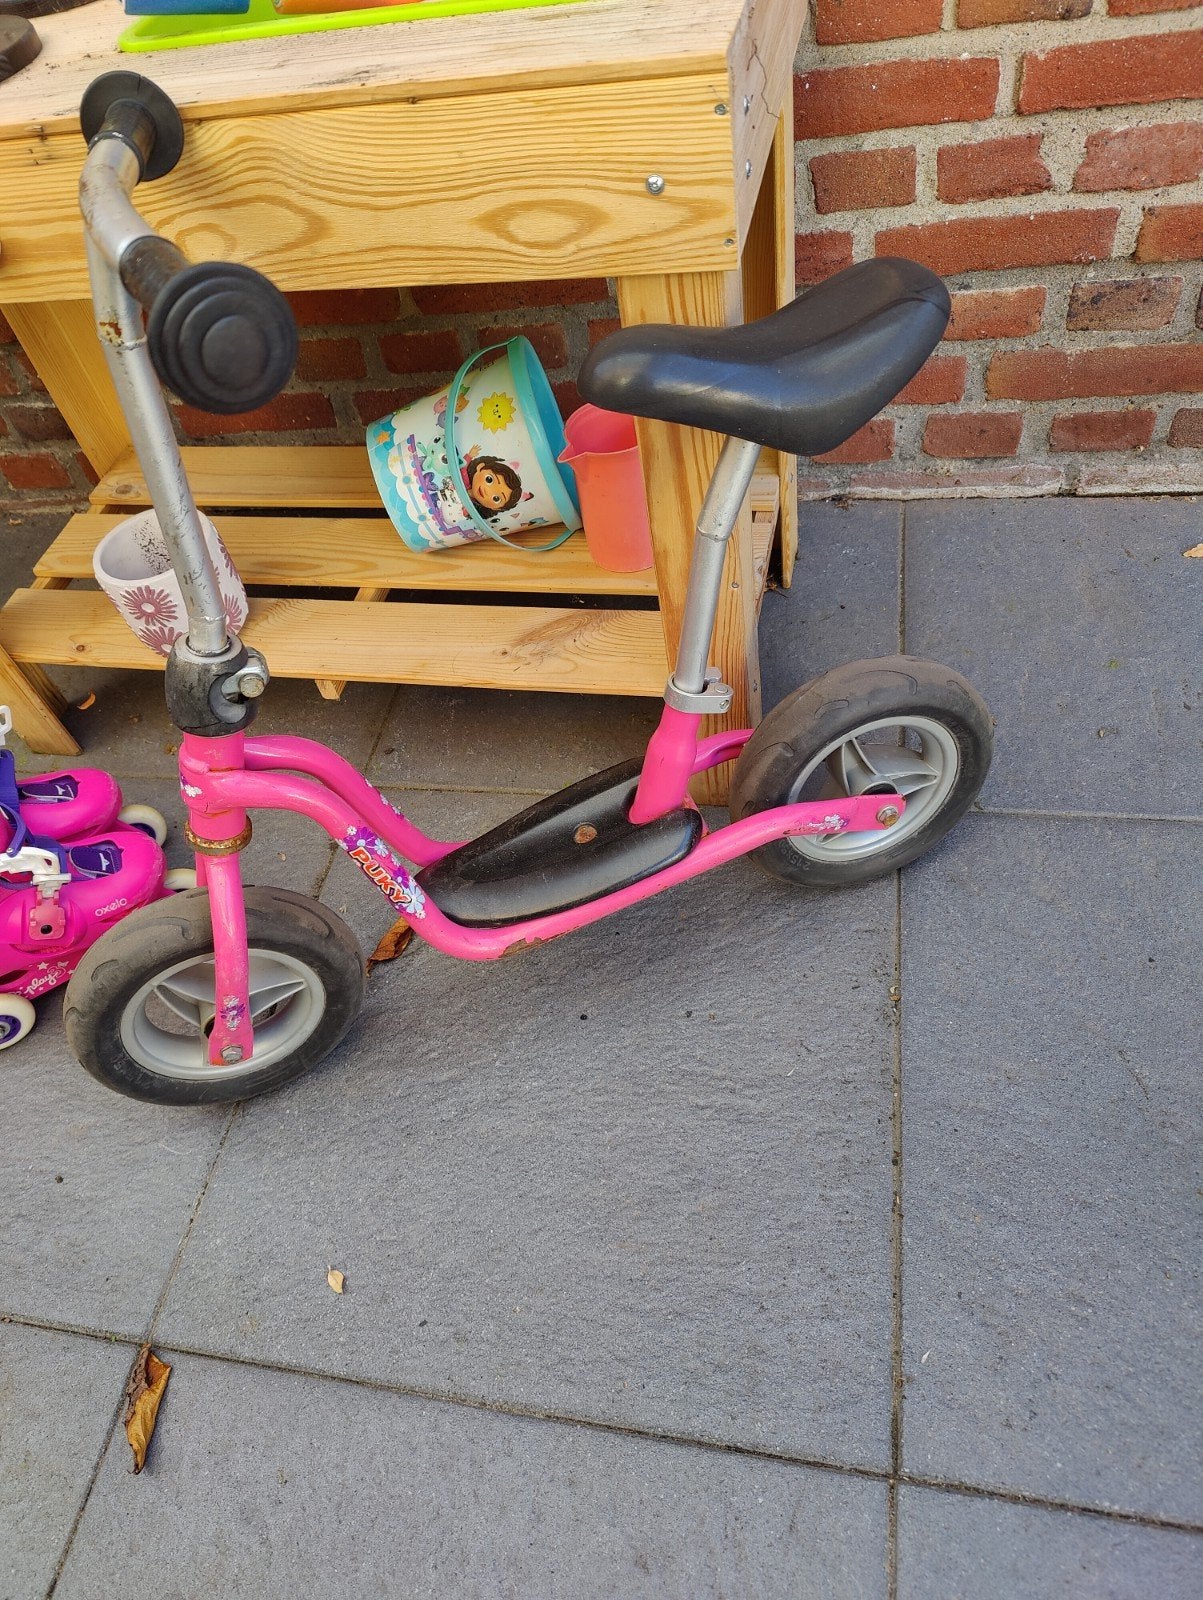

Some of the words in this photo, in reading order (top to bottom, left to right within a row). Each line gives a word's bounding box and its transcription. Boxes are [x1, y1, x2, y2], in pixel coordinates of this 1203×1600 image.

[349, 847, 412, 903] PUKY
[95, 898, 127, 917] oxelo
[24, 972, 58, 995] play
